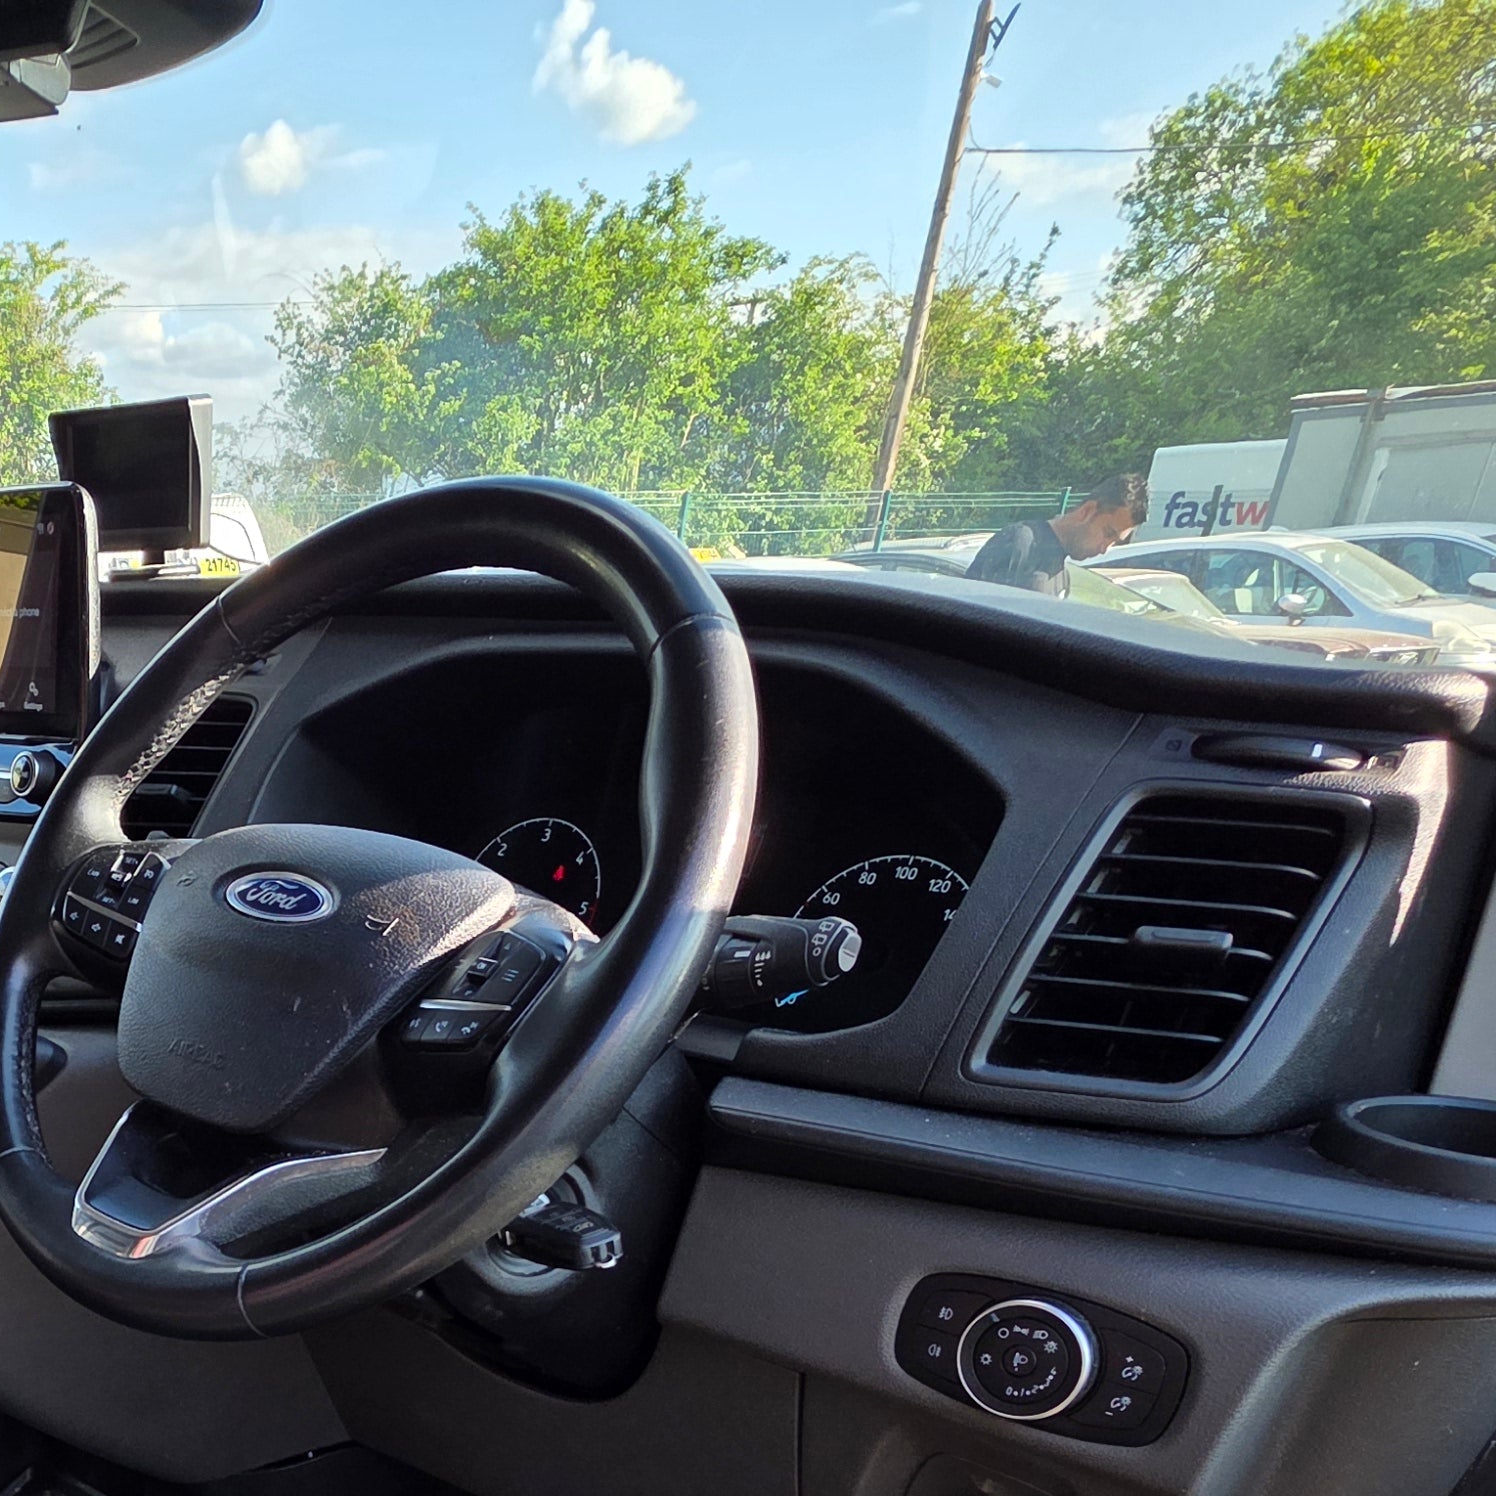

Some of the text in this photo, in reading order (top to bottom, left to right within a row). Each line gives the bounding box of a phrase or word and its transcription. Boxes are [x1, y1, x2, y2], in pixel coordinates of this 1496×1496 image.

[540, 828, 552, 842] 3
[497, 843, 508, 857] 2
[858, 872, 877, 885] 80
[895, 866, 918, 880] 100
[928, 879, 952, 893] 120
[245, 879, 308, 911] Ford
[822, 892, 841, 905] 60
[578, 901, 589, 915] 5
